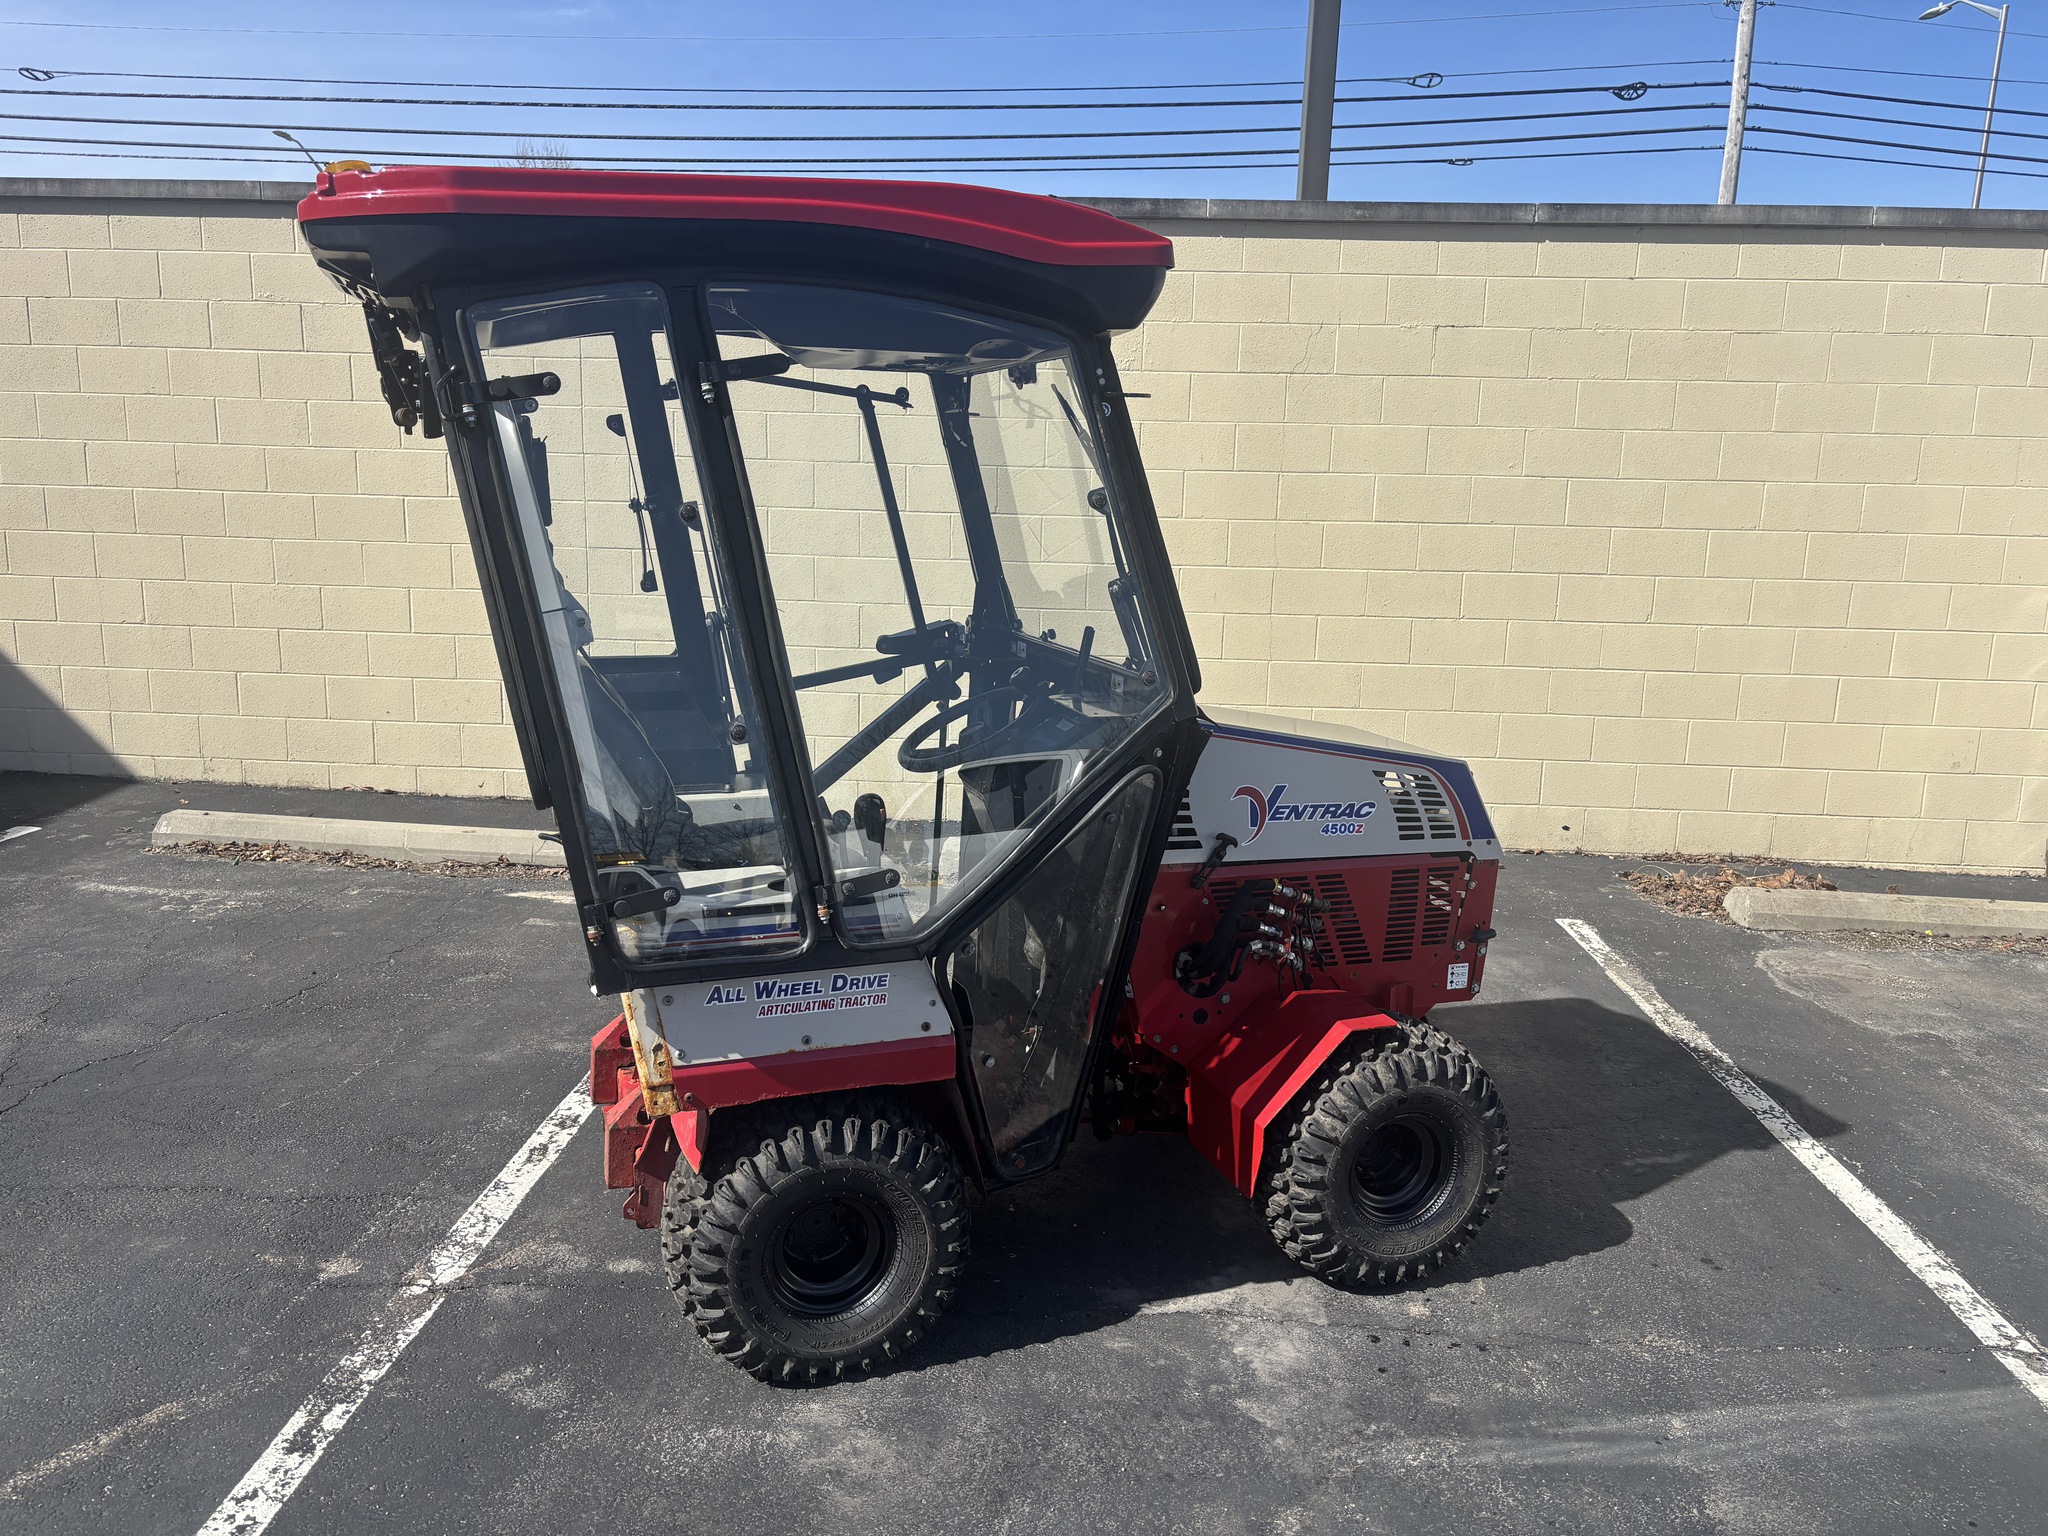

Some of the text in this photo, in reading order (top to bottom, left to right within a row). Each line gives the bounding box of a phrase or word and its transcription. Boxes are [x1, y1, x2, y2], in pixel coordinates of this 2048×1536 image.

[1231, 784, 1377, 838] VENTRAC
[704, 972, 890, 1006] ALL WHEEL DRIVE
[756, 992, 889, 1019] ARTICULATING TRACTOR
